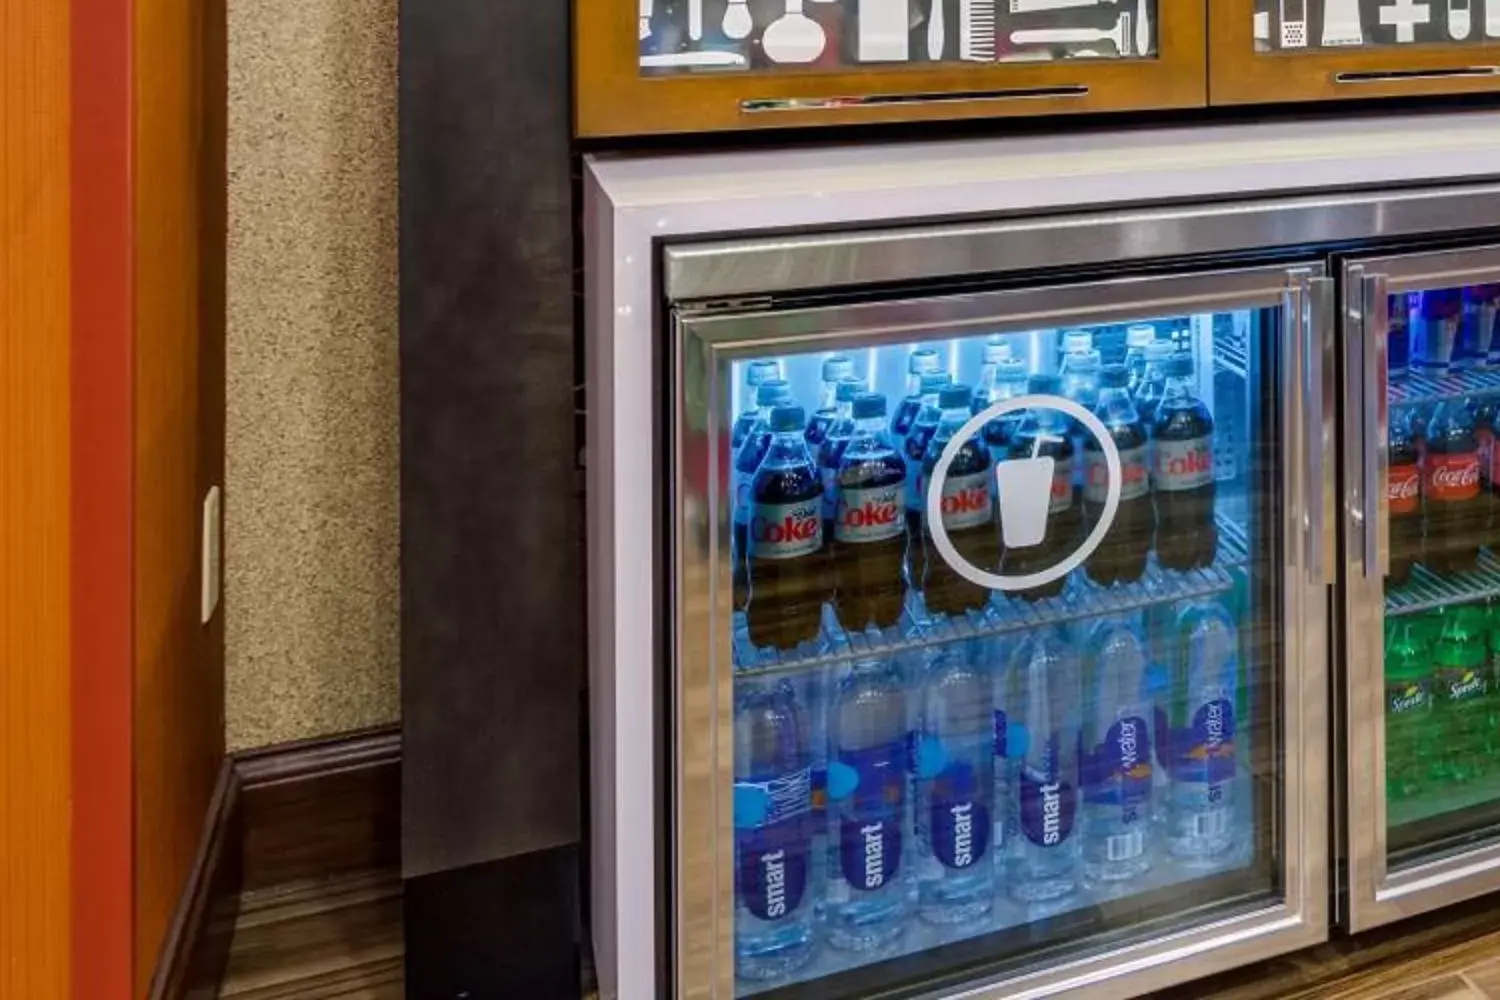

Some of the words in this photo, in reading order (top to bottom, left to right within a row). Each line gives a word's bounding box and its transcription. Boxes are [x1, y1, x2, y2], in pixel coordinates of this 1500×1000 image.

[751, 514, 818, 544] Coke
[953, 802, 973, 868] smart
[1043, 781, 1061, 847] smart
[767, 850, 787, 919] smart
[865, 821, 884, 888] smart
